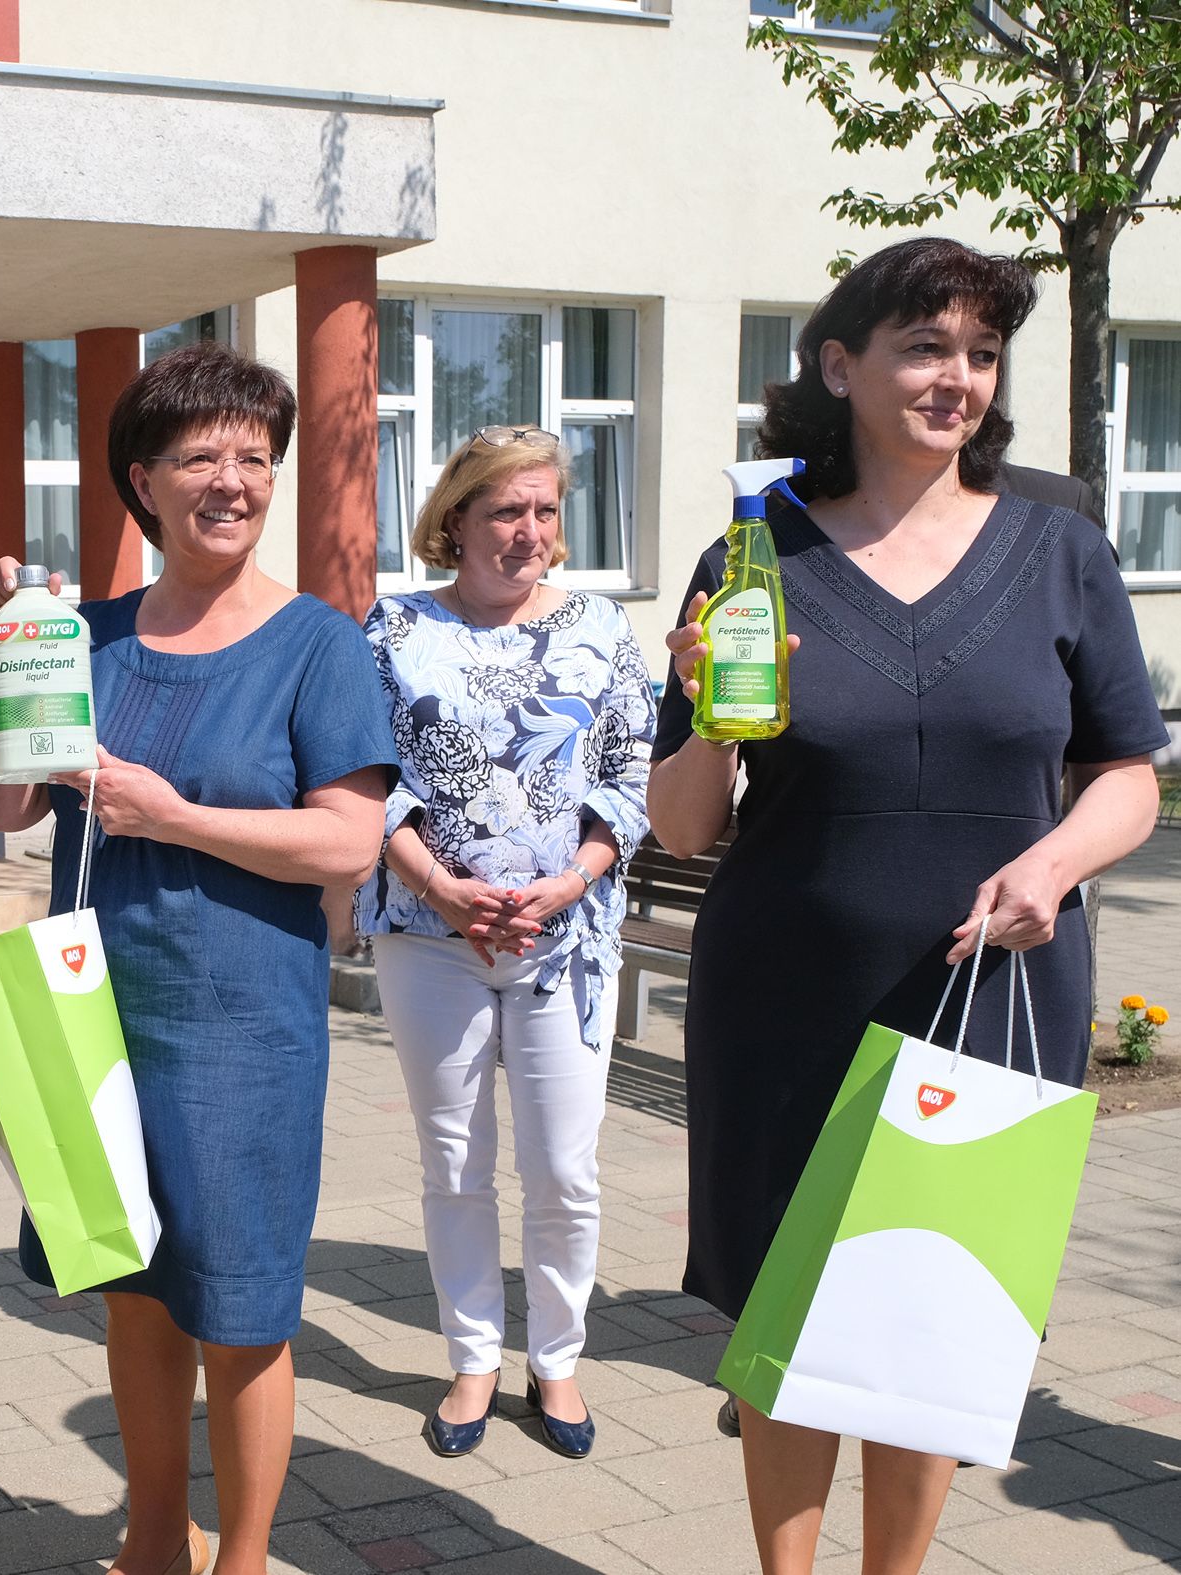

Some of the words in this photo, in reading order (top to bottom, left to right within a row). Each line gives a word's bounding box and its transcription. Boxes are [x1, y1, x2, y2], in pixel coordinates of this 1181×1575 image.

[40, 623, 75, 635] HYGI
[0, 657, 75, 673] Disinfectant
[26, 672, 49, 682] liquid
[66, 949, 81, 963] MOL
[920, 1088, 944, 1106] MOL
